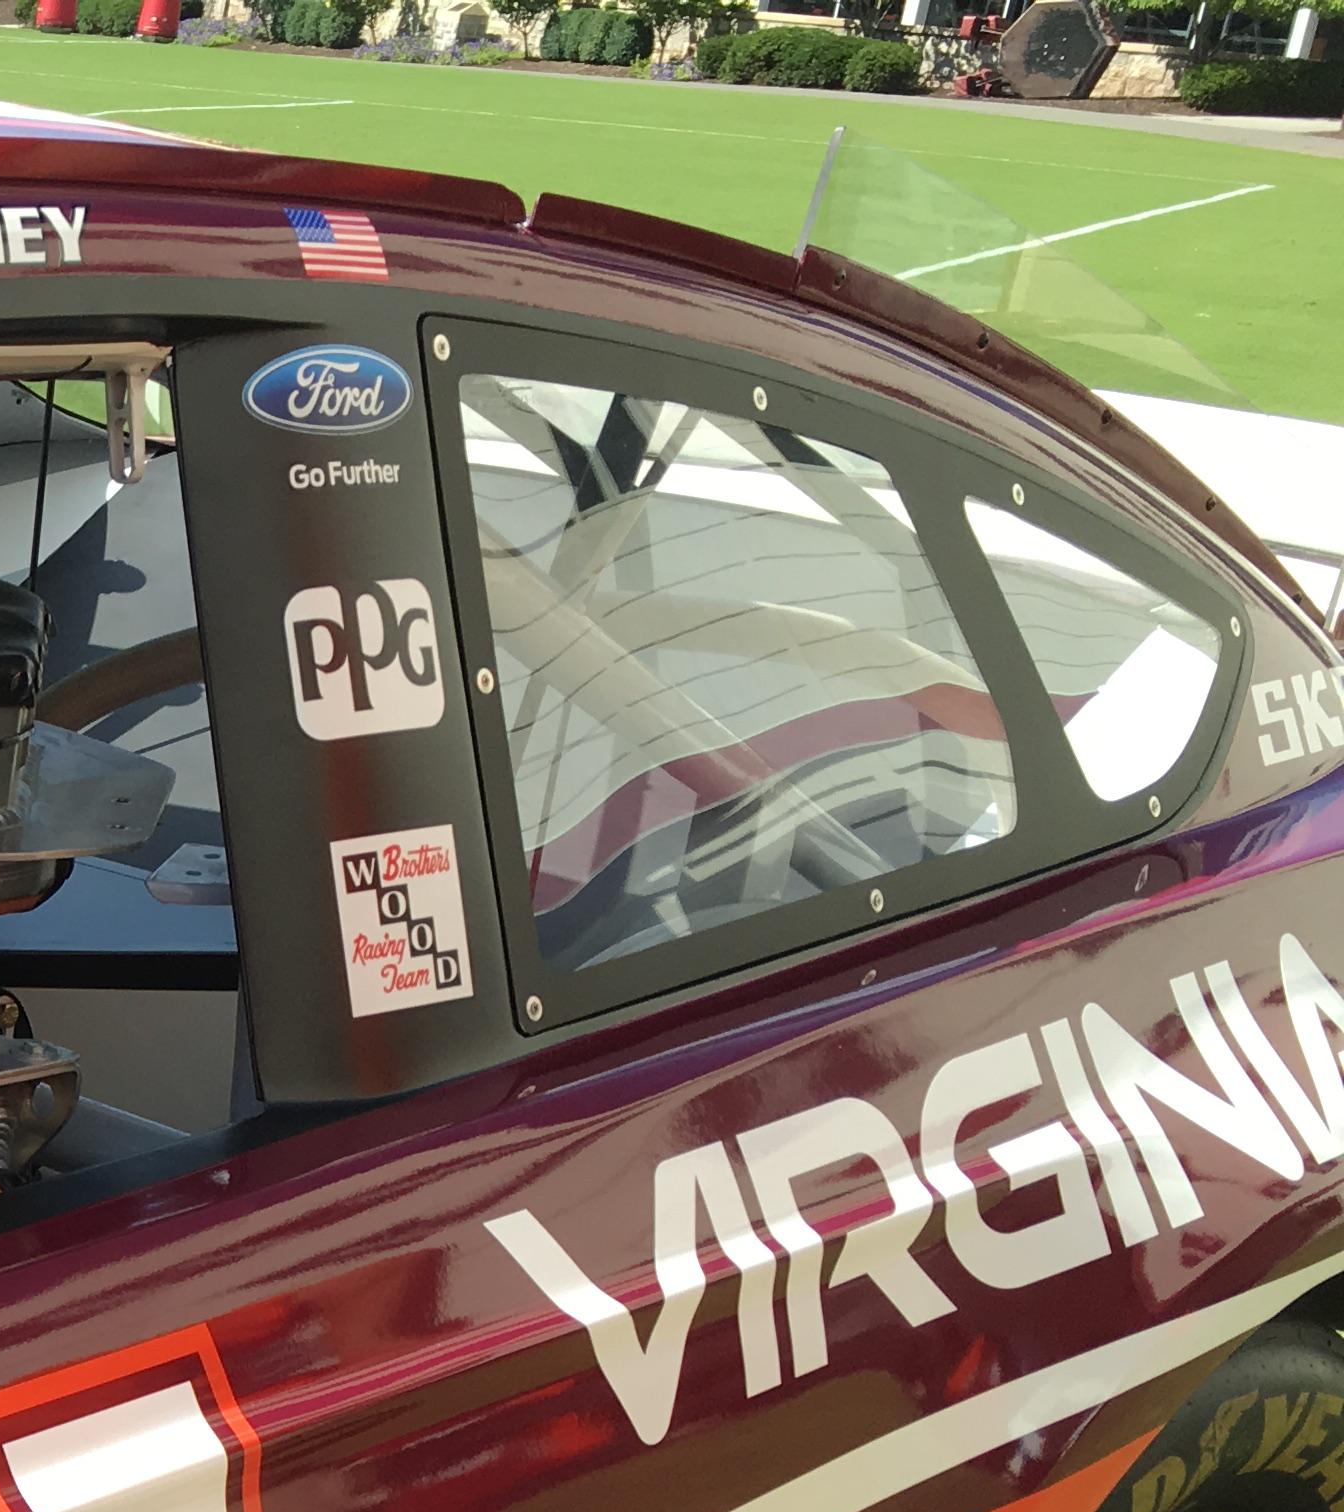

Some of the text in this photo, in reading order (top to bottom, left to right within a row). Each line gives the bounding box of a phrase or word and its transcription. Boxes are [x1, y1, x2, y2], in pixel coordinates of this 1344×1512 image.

[287, 359, 385, 419] Ford
[289, 458, 400, 490] Go Further
[1251, 666, 1344, 767] SK
[383, 844, 450, 881] Brothers
[352, 933, 406, 966] Racing
[381, 963, 431, 993] Team
